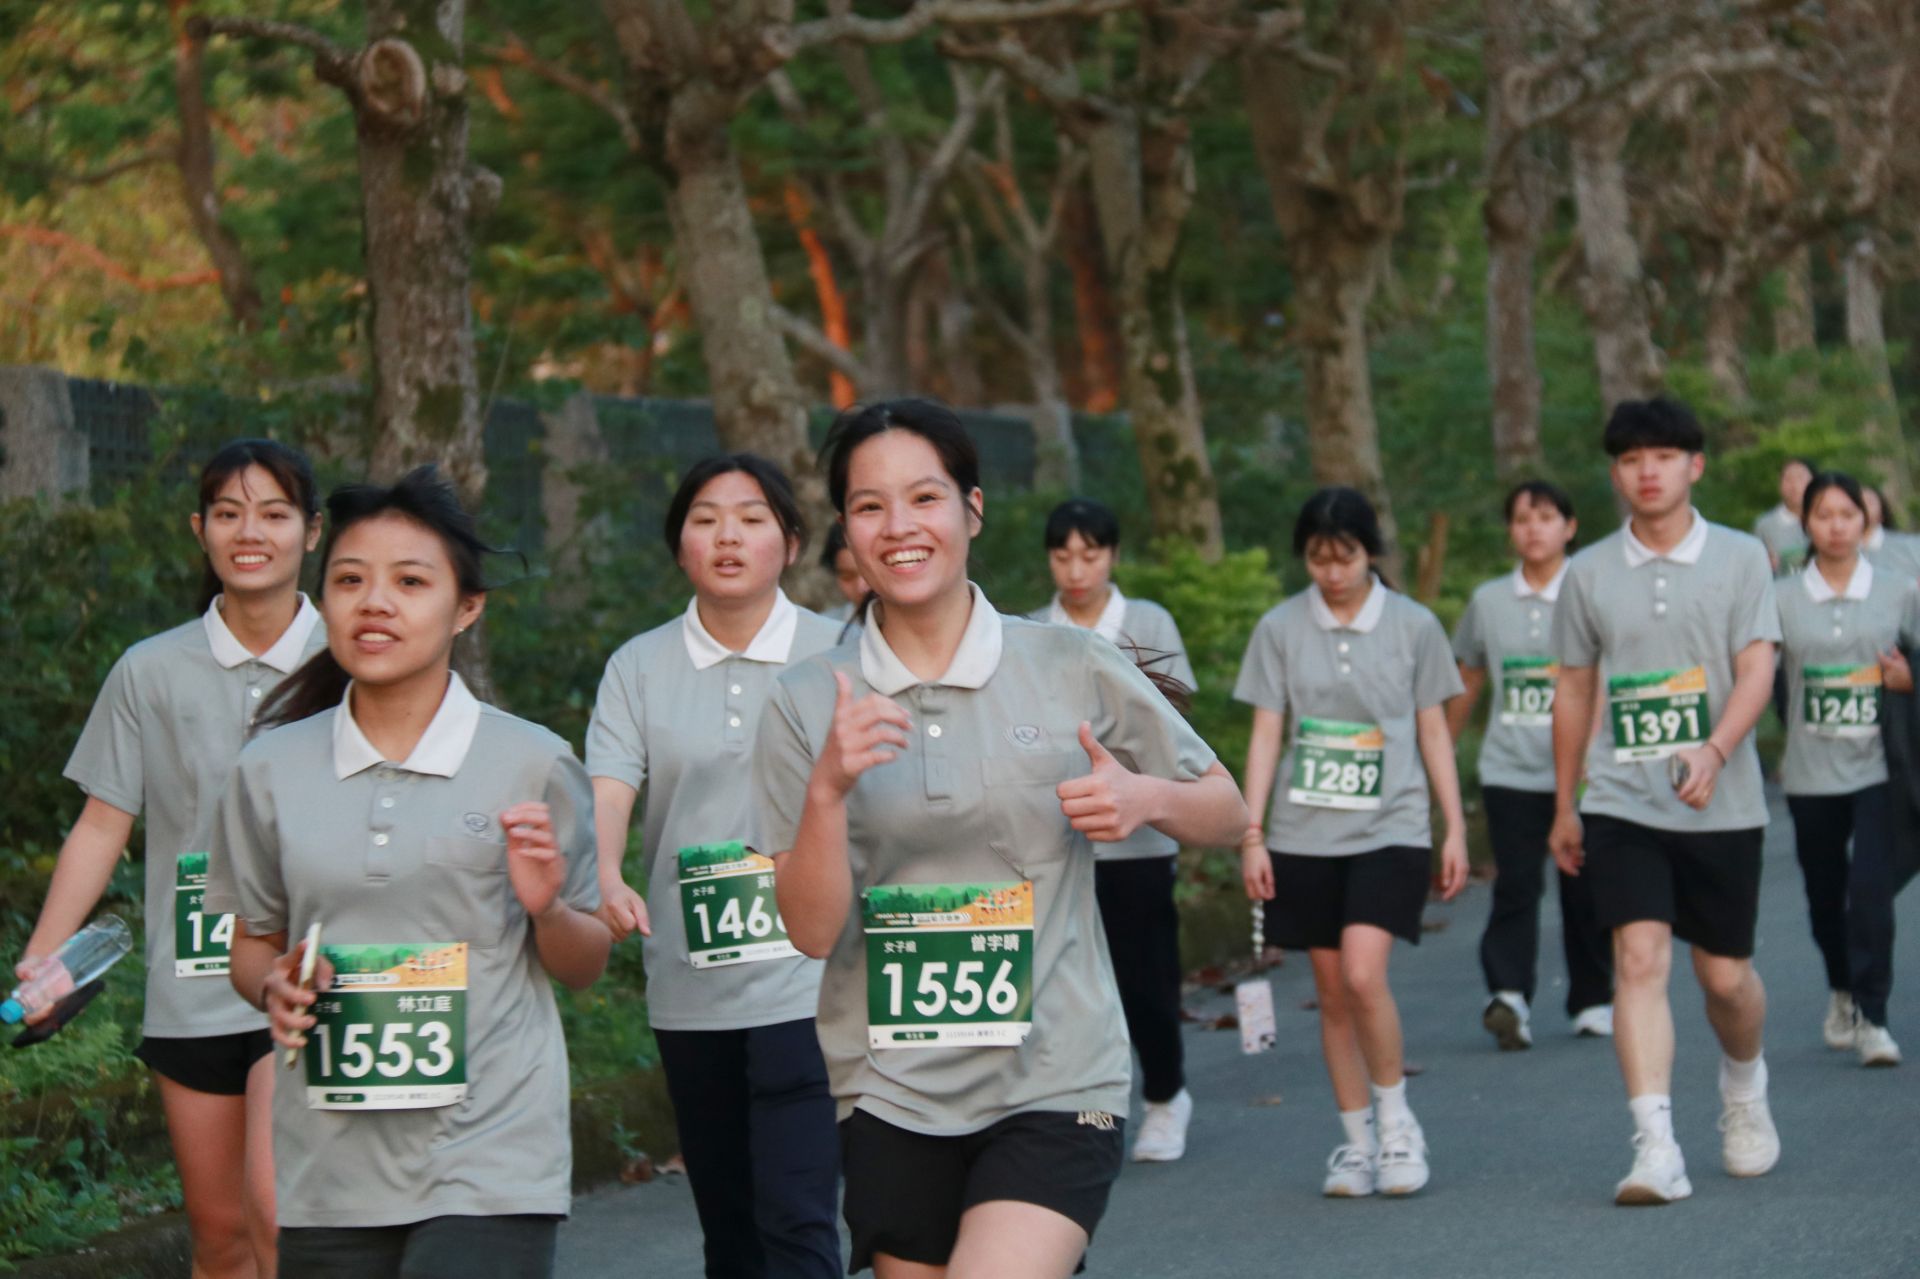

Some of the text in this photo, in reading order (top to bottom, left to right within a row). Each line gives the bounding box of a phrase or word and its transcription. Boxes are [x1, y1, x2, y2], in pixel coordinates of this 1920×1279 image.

[1621, 707, 1700, 745] 1391
[1810, 696, 1878, 724] 1245
[1302, 759, 1379, 794] 1289
[881, 959, 1018, 1017] 1556
[313, 1021, 455, 1078] 1553
